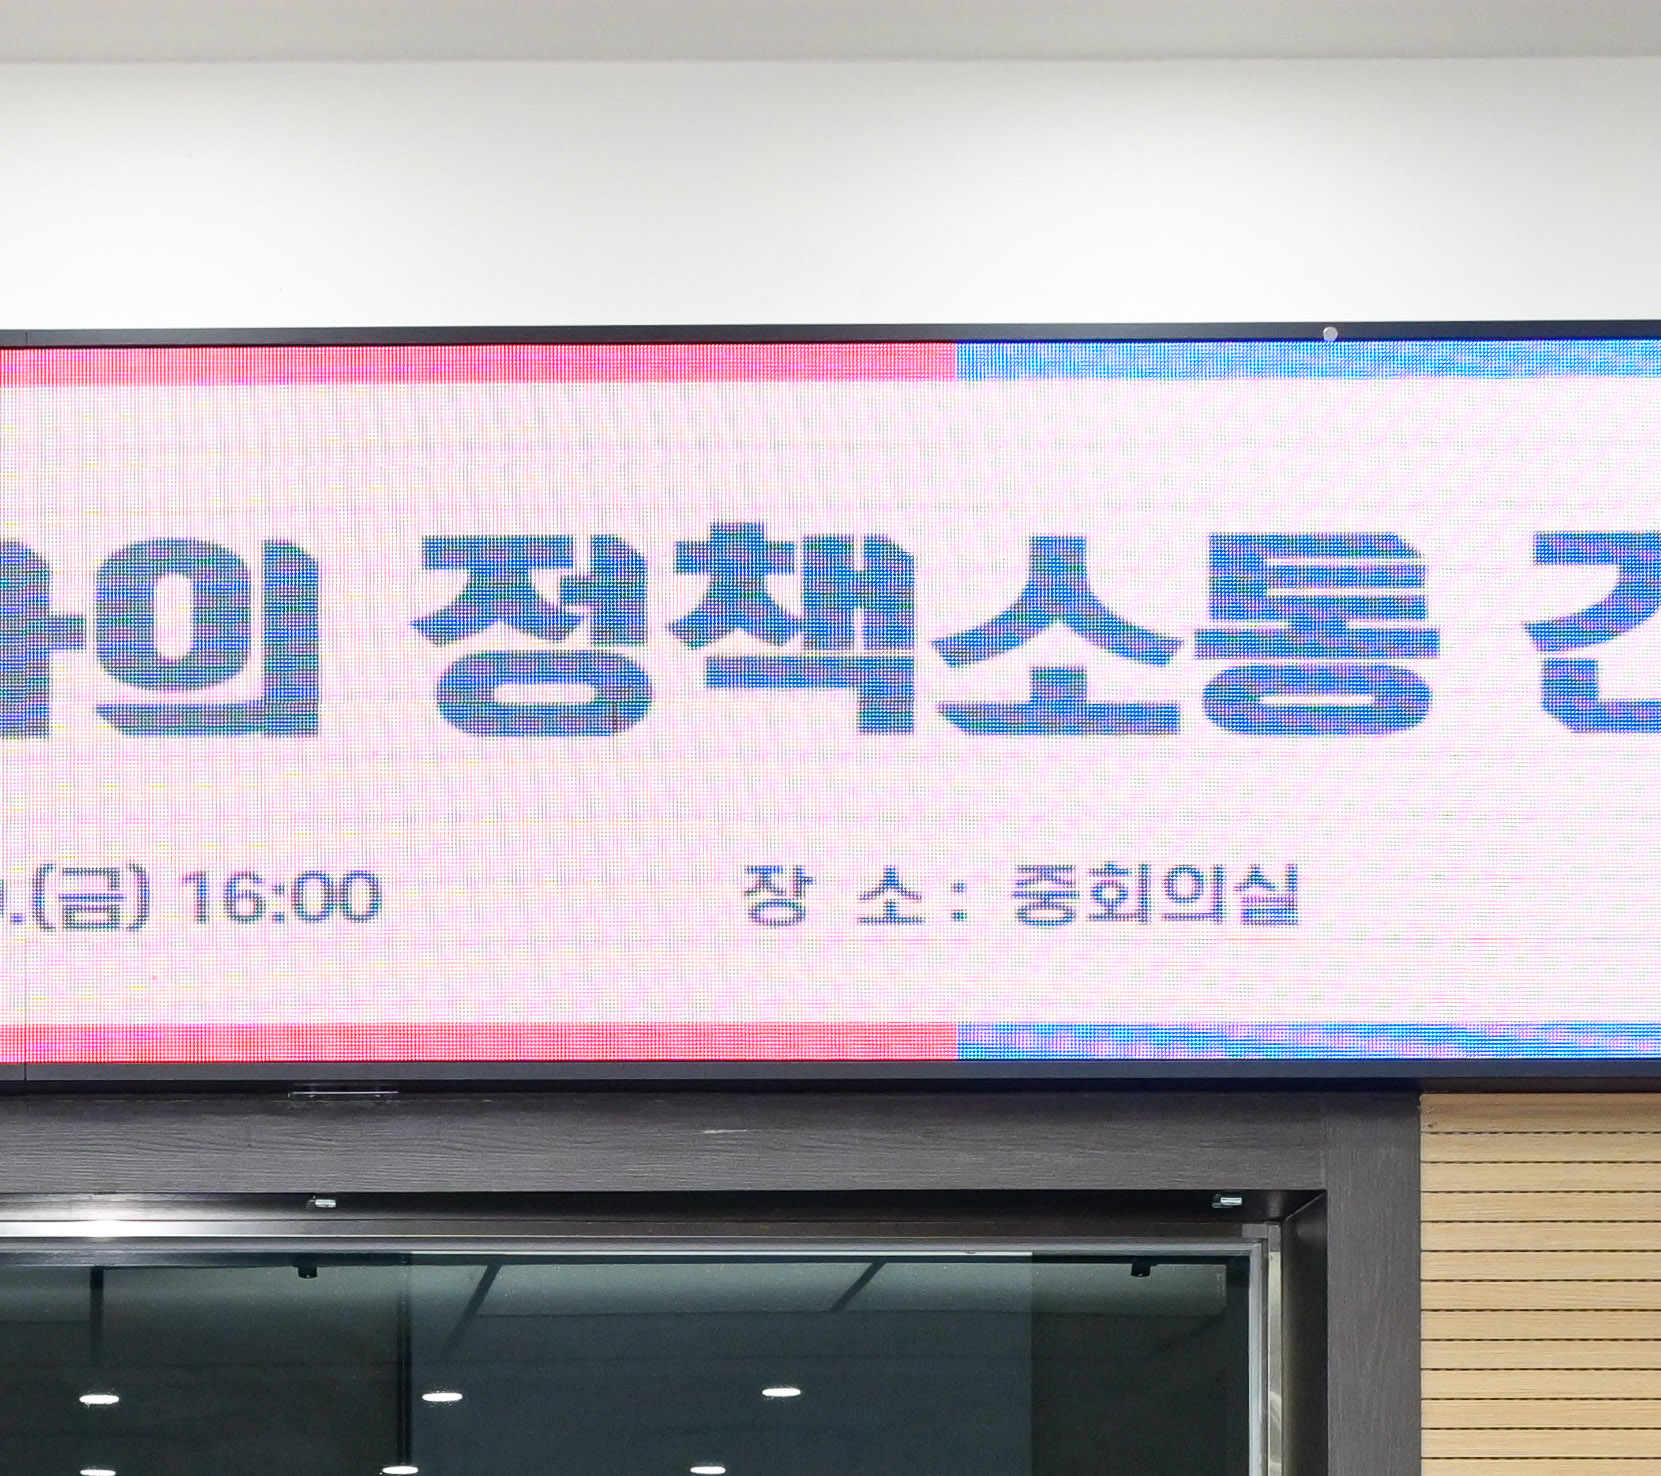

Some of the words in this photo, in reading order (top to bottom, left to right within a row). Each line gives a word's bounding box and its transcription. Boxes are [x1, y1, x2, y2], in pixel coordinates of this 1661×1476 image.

[411, 521, 1442, 737] 정책소통
[182, 869, 382, 926] 16:00
[744, 864, 814, 928] 장
[1011, 861, 1300, 928] 중회의실
